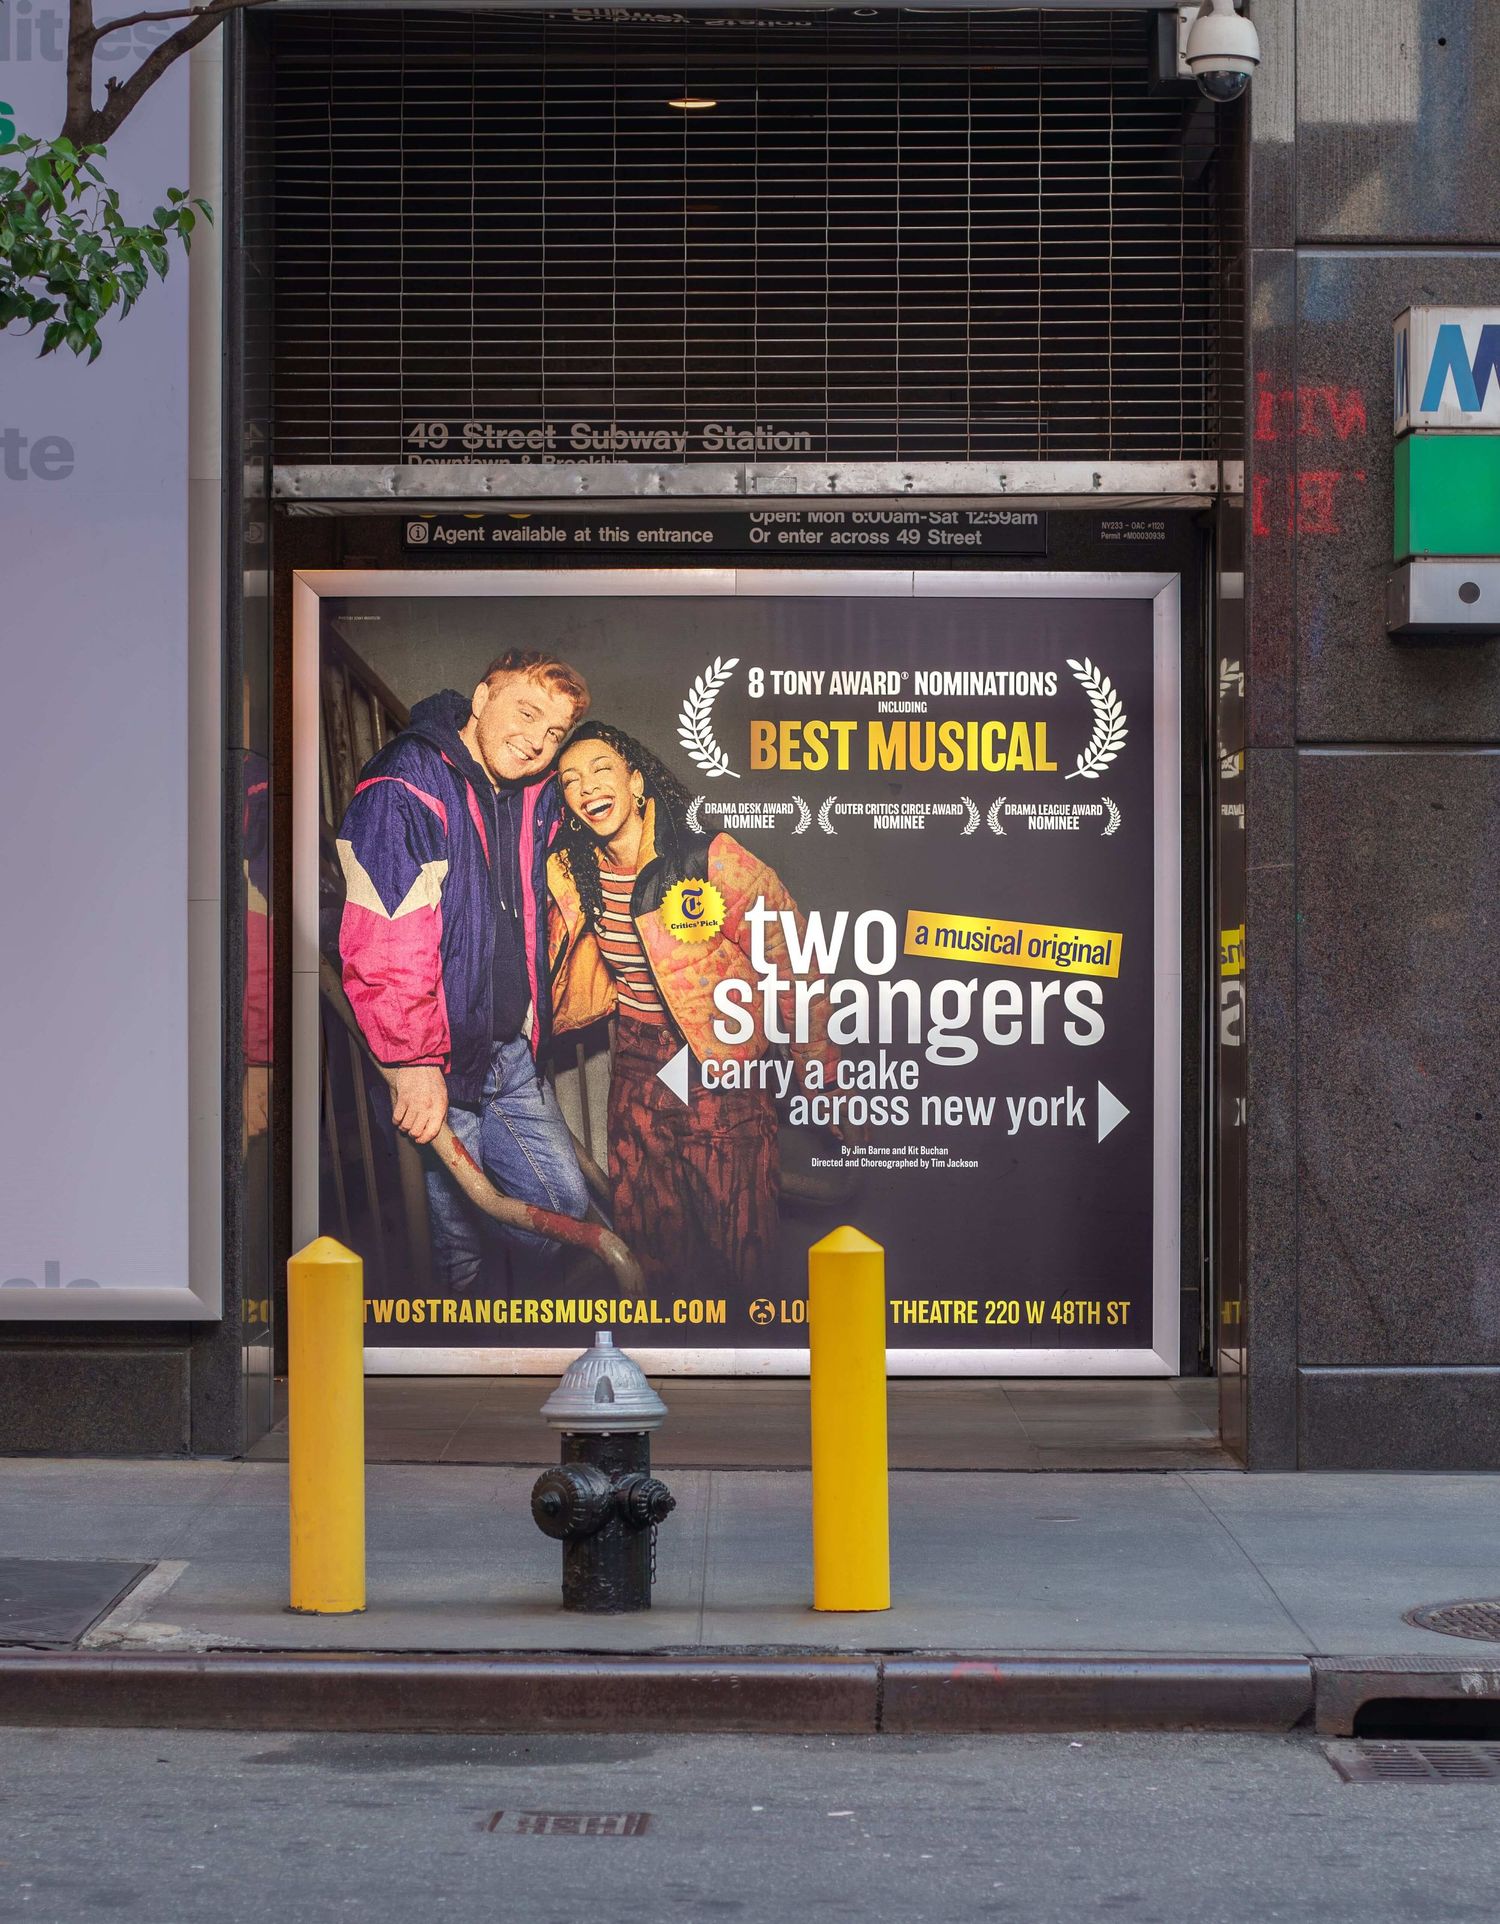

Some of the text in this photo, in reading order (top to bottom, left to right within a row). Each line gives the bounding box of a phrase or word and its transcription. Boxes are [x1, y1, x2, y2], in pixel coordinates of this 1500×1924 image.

[407, 423, 811, 453] 49 Street Subway Station
[750, 512, 800, 527] Open:
[807, 512, 845, 524] Mon
[965, 512, 1038, 525] 12:59am
[433, 526, 713, 544] Agent available at this entrance
[750, 528, 982, 546] Or enter across 49 Street
[1101, 532, 1121, 540] Permit
[748, 667, 764, 697] 8
[770, 670, 828, 695] TONY
[914, 671, 1058, 697] NOMINATIONS
[878, 701, 927, 714] INCLUDING
[750, 720, 1057, 772] BEST MUSICAL
[705, 803, 794, 815] DRAMA DESK AWARD
[835, 804, 963, 815] OUTER CRITICS CIRCLE AWARD
[1004, 804, 1103, 816] DRAMA LEAGUE AWARD
[723, 815, 775, 829] NOMINEE
[873, 816, 925, 830] NOMINEE
[1028, 816, 1080, 830] NOMINEE
[745, 895, 897, 976] two
[915, 925, 1112, 968] a musical original
[713, 975, 1105, 1066] strangers
[701, 1049, 919, 1098] carry a cake
[789, 1086, 1086, 1136] across new york
[841, 1146, 949, 1156] By Jim Barne and Kit Buchan
[811, 1158, 978, 1169] Directed and Choreographed by Tim Jackson
[364, 1298, 727, 1324] TWOSTRANGERSMUSICAL.COM
[890, 1300, 978, 1324] THEATRE
[985, 1300, 1020, 1325] 220
[1025, 1300, 1045, 1325] W
[1051, 1300, 1100, 1325] 48TH
[1107, 1301, 1131, 1325] ST
